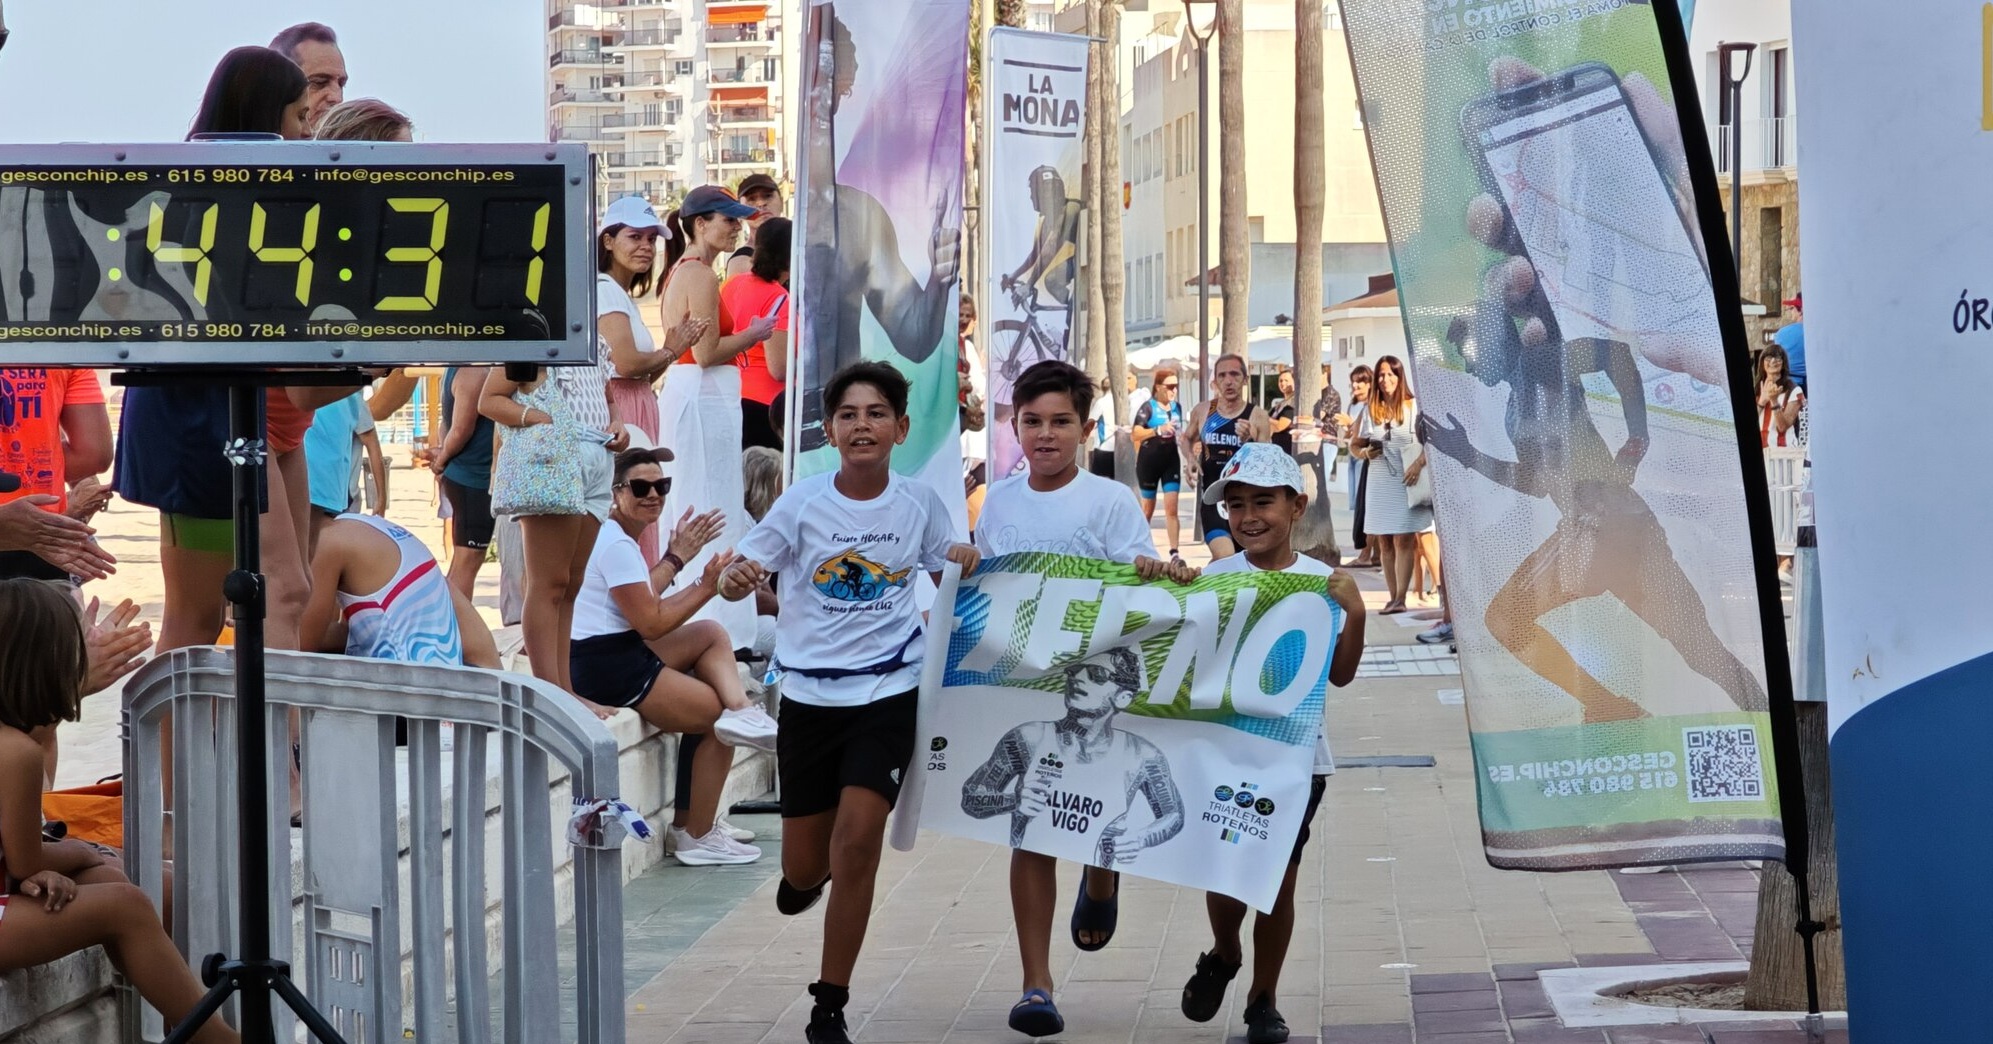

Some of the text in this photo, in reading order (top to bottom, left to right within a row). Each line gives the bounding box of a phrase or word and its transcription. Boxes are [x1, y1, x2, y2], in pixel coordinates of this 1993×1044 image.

[1029, 73, 1054, 95] LA
[1003, 93, 1080, 127] MONA
[1, 168, 515, 184] gesconchip.es 615 980 784 info@gesconchip.es
[1953, 288, 1993, 334] ÓR
[0, 322, 505, 339] gesconchip.es 615 980 784 info@gesconchip.es
[17, 382, 46, 392] para
[17, 391, 42, 418] TÍ
[930, 752, 945, 761] AS
[965, 795, 1004, 807] PISCINA
[1052, 810, 1089, 834] VIGO
[1202, 812, 1268, 840] ROTEÑOS
[1209, 801, 1269, 828] TRIATLETAS
